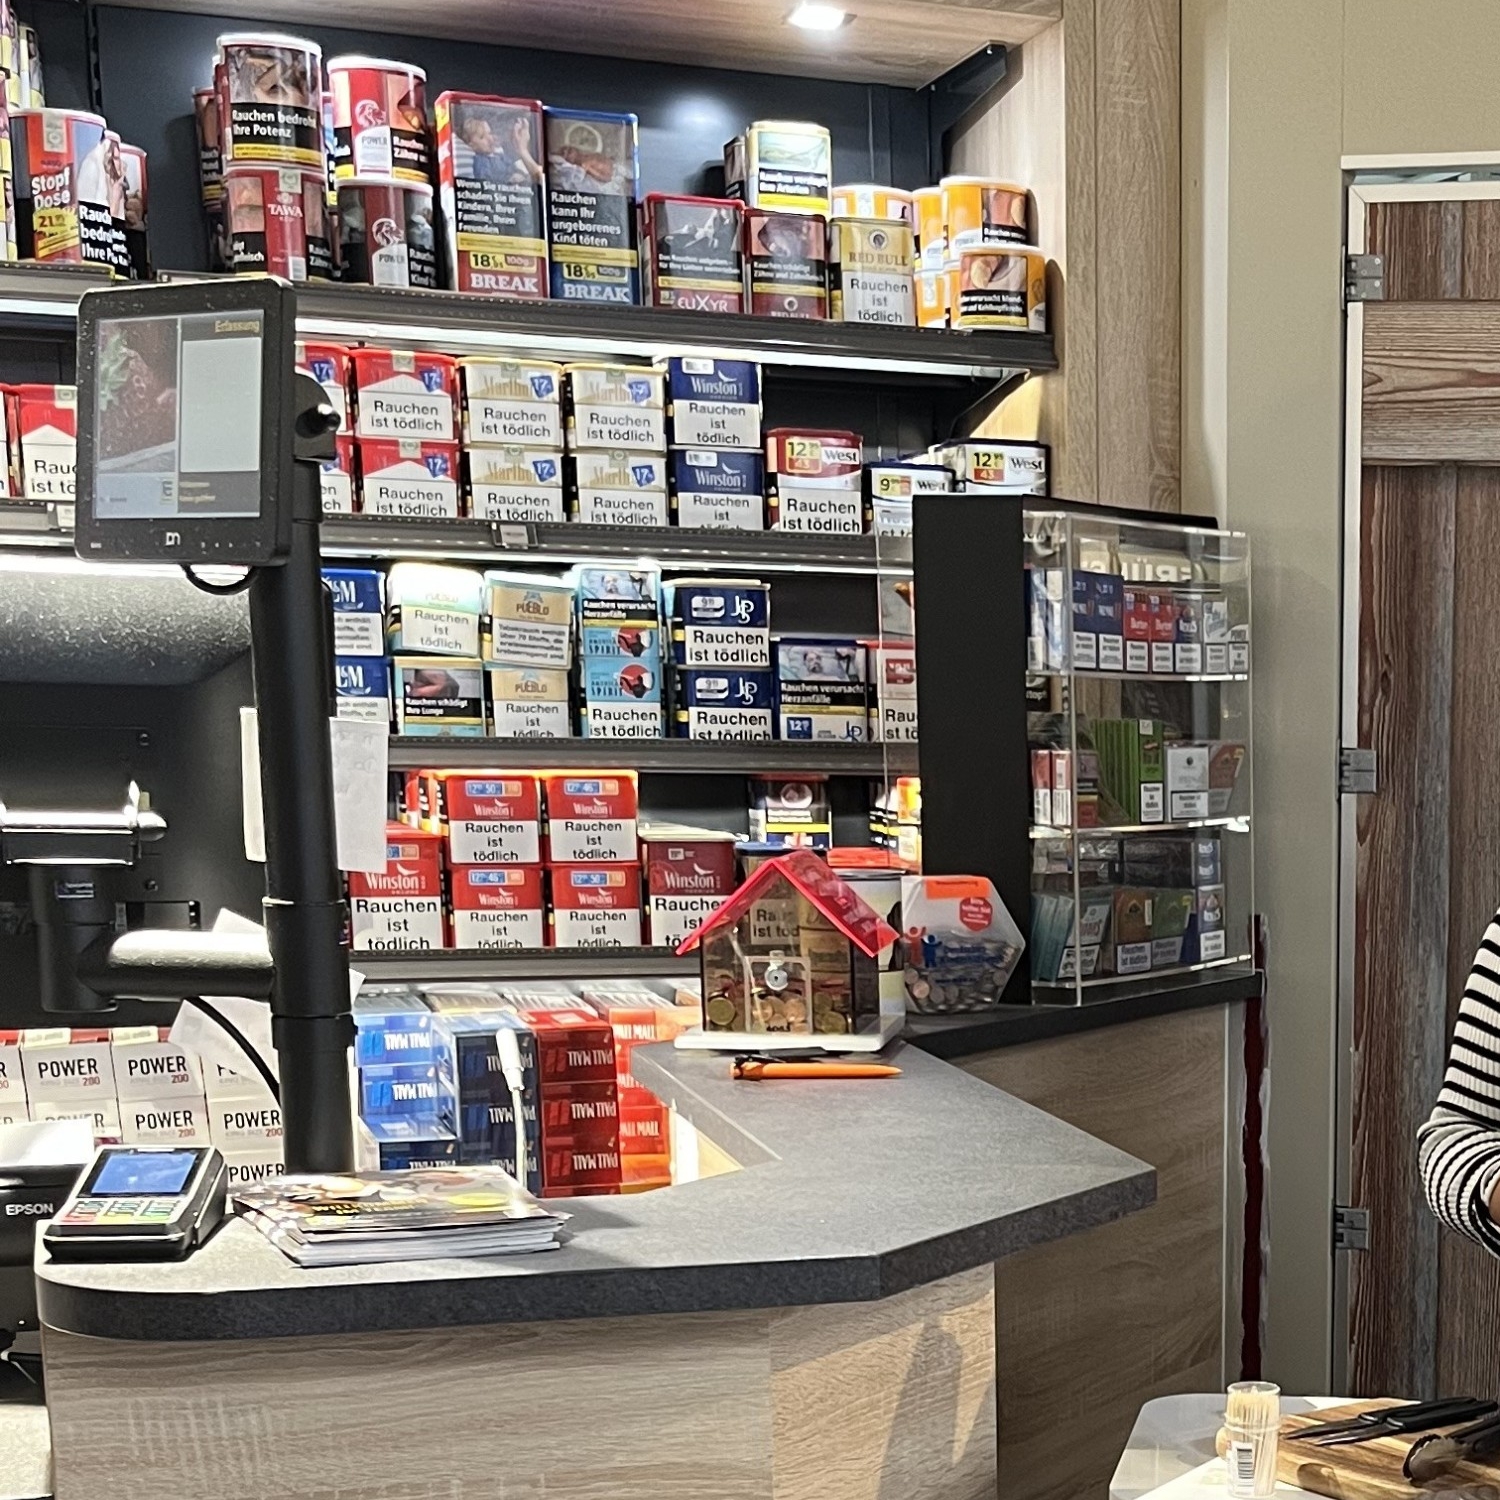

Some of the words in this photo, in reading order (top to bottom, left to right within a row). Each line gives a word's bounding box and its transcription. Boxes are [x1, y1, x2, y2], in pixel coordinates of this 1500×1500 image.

[232, 109, 275, 122] Rauchen
[278, 108, 316, 129] bedroht
[232, 125, 250, 136] Ihre
[253, 125, 292, 138] Potenz
[32, 166, 69, 195] Stopf
[457, 179, 481, 189] Wenn
[484, 181, 496, 190] Sie
[498, 183, 534, 195] rauchen,
[34, 191, 70, 211] Dose
[457, 191, 492, 202] schaden
[494, 192, 507, 203] Sie
[551, 191, 597, 205] Rauchen
[267, 204, 303, 218] TAWA
[458, 201, 493, 213] Kindern,
[551, 205, 578, 218] kann
[580, 206, 595, 218] Ihr
[458, 212, 492, 224] Familie,
[552, 219, 621, 235] ungeborenes
[553, 232, 577, 245] Kind
[579, 233, 608, 247] töten
[849, 251, 875, 264] RED
[877, 252, 908, 266] BULL
[470, 273, 538, 292] BREAK
[850, 278, 908, 294] Rauchen
[563, 283, 630, 301] BREAK
[872, 294, 888, 307] ist
[858, 309, 903, 323] tödlich
[691, 376, 738, 396] Winston
[374, 400, 439, 416] Rauchen
[484, 407, 547, 422] Rauchen
[689, 402, 746, 417] Rauchen
[371, 416, 389, 428] ist
[393, 416, 443, 432] tödlich
[590, 413, 651, 428] Rauchen
[710, 418, 726, 429] ist
[481, 422, 498, 434] ist
[503, 423, 551, 438] tödlich
[587, 428, 604, 440] ist
[608, 428, 654, 443] tödlich
[696, 432, 741, 444] tödlich
[825, 449, 857, 462] West
[1011, 457, 1043, 471] West
[695, 469, 741, 487] Winston
[32, 480, 53, 494] ist
[917, 480, 945, 491] West
[379, 486, 443, 502] Rauchen
[487, 492, 550, 507] Rauchen
[593, 497, 654, 511] Rauchen
[693, 495, 750, 508] Rauchen
[787, 498, 856, 515] Rauchen
[376, 502, 394, 514] ist
[398, 502, 447, 517] tödlich
[484, 507, 502, 520] ist
[506, 508, 554, 522] tödlich
[714, 510, 730, 521] ist
[591, 511, 607, 523] ist
[612, 511, 658, 526] tödlich
[783, 517, 802, 531] ist
[807, 517, 861, 533] tödlich
[415, 609, 469, 625] Rauchen
[434, 625, 449, 636] ist
[693, 630, 764, 645] Rauchen
[420, 637, 462, 651] tödlich
[690, 649, 709, 661] ist
[714, 649, 767, 663] tödlich
[781, 682, 818, 693] Rauchen
[820, 683, 864, 694] verursacht
[781, 694, 831, 705] Herzanfälle
[506, 703, 559, 715] Rauchen
[593, 708, 658, 722] Rauchen
[525, 716, 540, 727] ist
[697, 712, 767, 727] Rauchen
[590, 726, 606, 737] ist
[612, 725, 661, 738] tödlich
[693, 730, 712, 740] ist
[717, 730, 770, 740] tödlich
[465, 822, 524, 834] Rauchen
[565, 821, 622, 833] Rauchen
[487, 836, 503, 848] ist
[586, 835, 602, 846] ist
[473, 850, 519, 862] tödlich
[573, 848, 617, 860] tödlich
[366, 872, 419, 890] Winston
[664, 868, 715, 889] Winston
[356, 898, 437, 913] Rauchen
[470, 911, 528, 923] Rauchen
[569, 911, 626, 923] Rauchen
[683, 916, 702, 930] ist
[387, 919, 409, 932] ist
[492, 925, 507, 936] ist
[591, 924, 606, 936] ist
[367, 936, 430, 950] tödlich
[478, 939, 522, 948] tödlich
[577, 938, 621, 947] tödlich
[634, 1024, 656, 1040] MALL
[384, 1033, 408, 1050] MALL
[568, 1050, 592, 1066] MALL
[593, 1049, 613, 1065] PALL
[38, 1058, 98, 1078] POWER
[128, 1056, 187, 1076] POWER
[82, 1077, 101, 1087] 200
[171, 1073, 189, 1084] 200
[392, 1084, 415, 1101] MALL
[571, 1103, 594, 1119] MALL
[596, 1102, 616, 1118] PALL
[135, 1110, 193, 1130] POWER
[223, 1109, 280, 1129] POWER
[178, 1127, 195, 1138] 200
[266, 1127, 283, 1137] 200
[636, 1121, 660, 1137] MALL
[573, 1155, 596, 1171] MALL
[598, 1153, 618, 1170] PALL
[229, 1164, 285, 1182] POWER
[5, 1202, 54, 1216] EPSON
